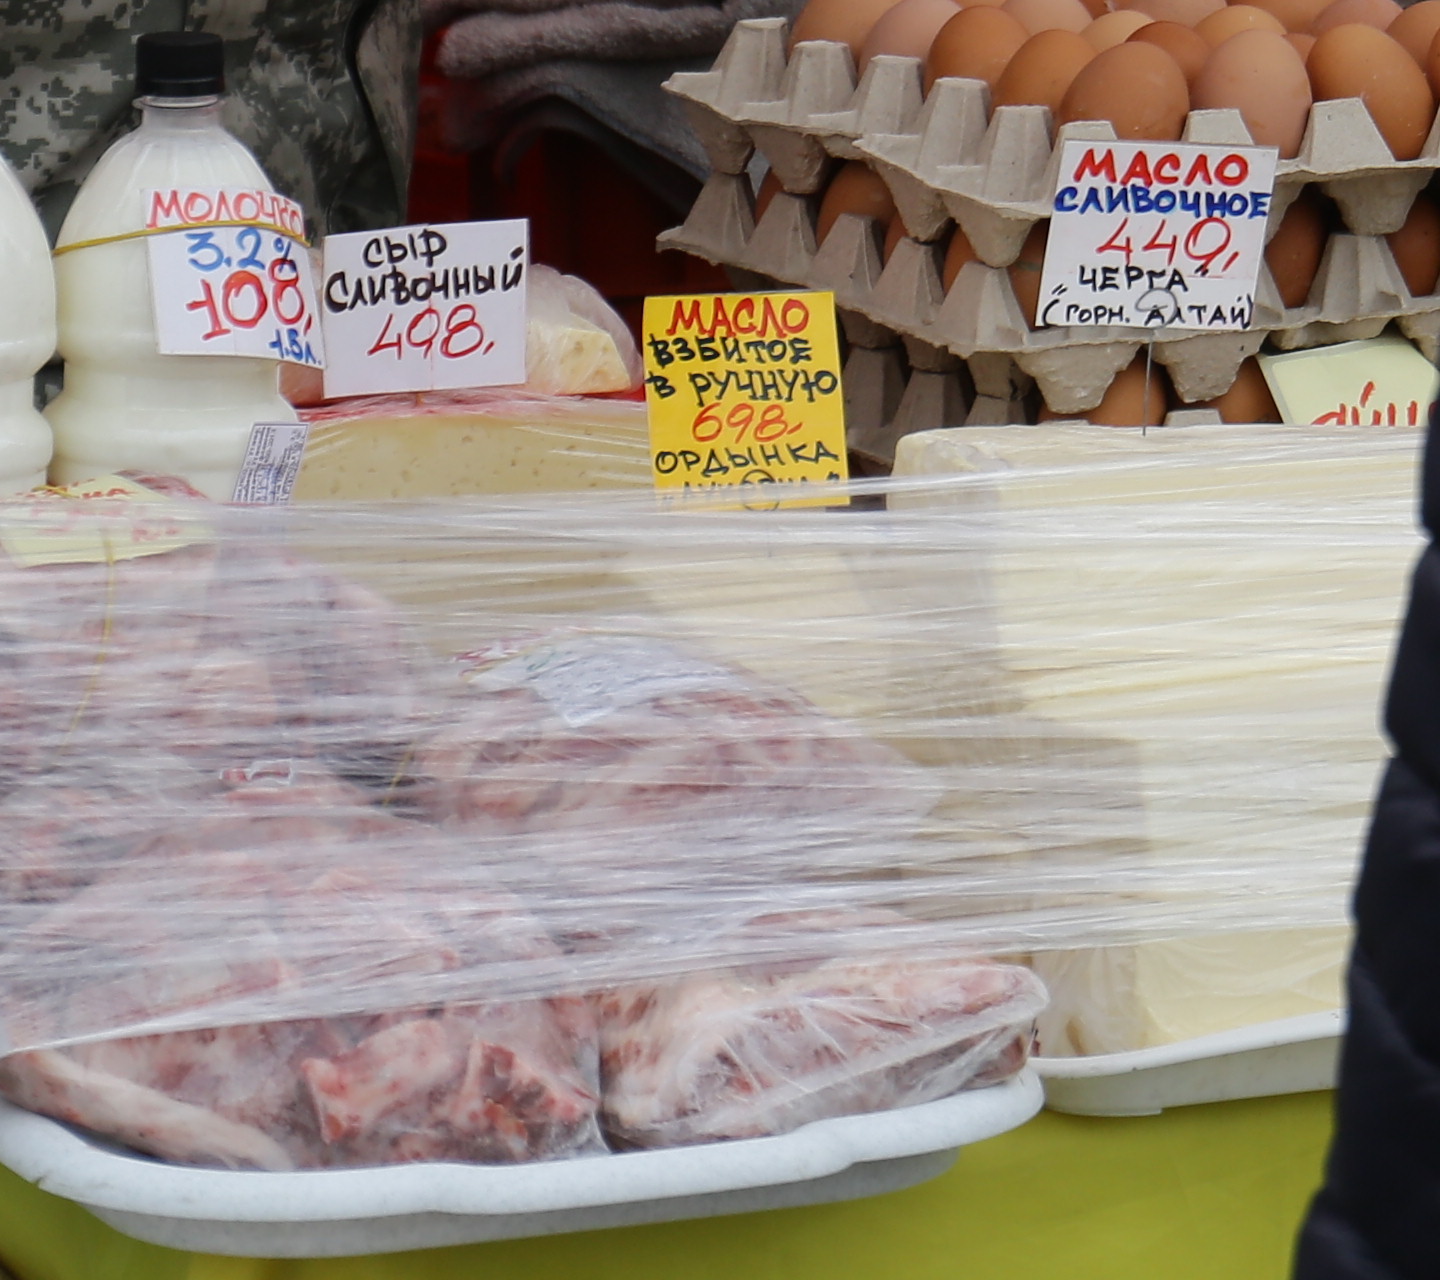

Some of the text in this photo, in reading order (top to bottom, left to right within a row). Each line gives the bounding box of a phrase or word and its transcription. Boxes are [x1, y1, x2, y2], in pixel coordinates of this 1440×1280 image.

[1073, 148, 1250, 187] МАСЛО
[145, 189, 306, 240] МОЛОЧКО
[1054, 184, 1273, 219] СЛИВОЧНОЕ
[665, 297, 810, 339] МАСЛО
[647, 333, 813, 368] ВЗБИТОЕ
[688, 369, 839, 407] РУЧНУЮ
[655, 440, 840, 478] ОРДЫНКА
